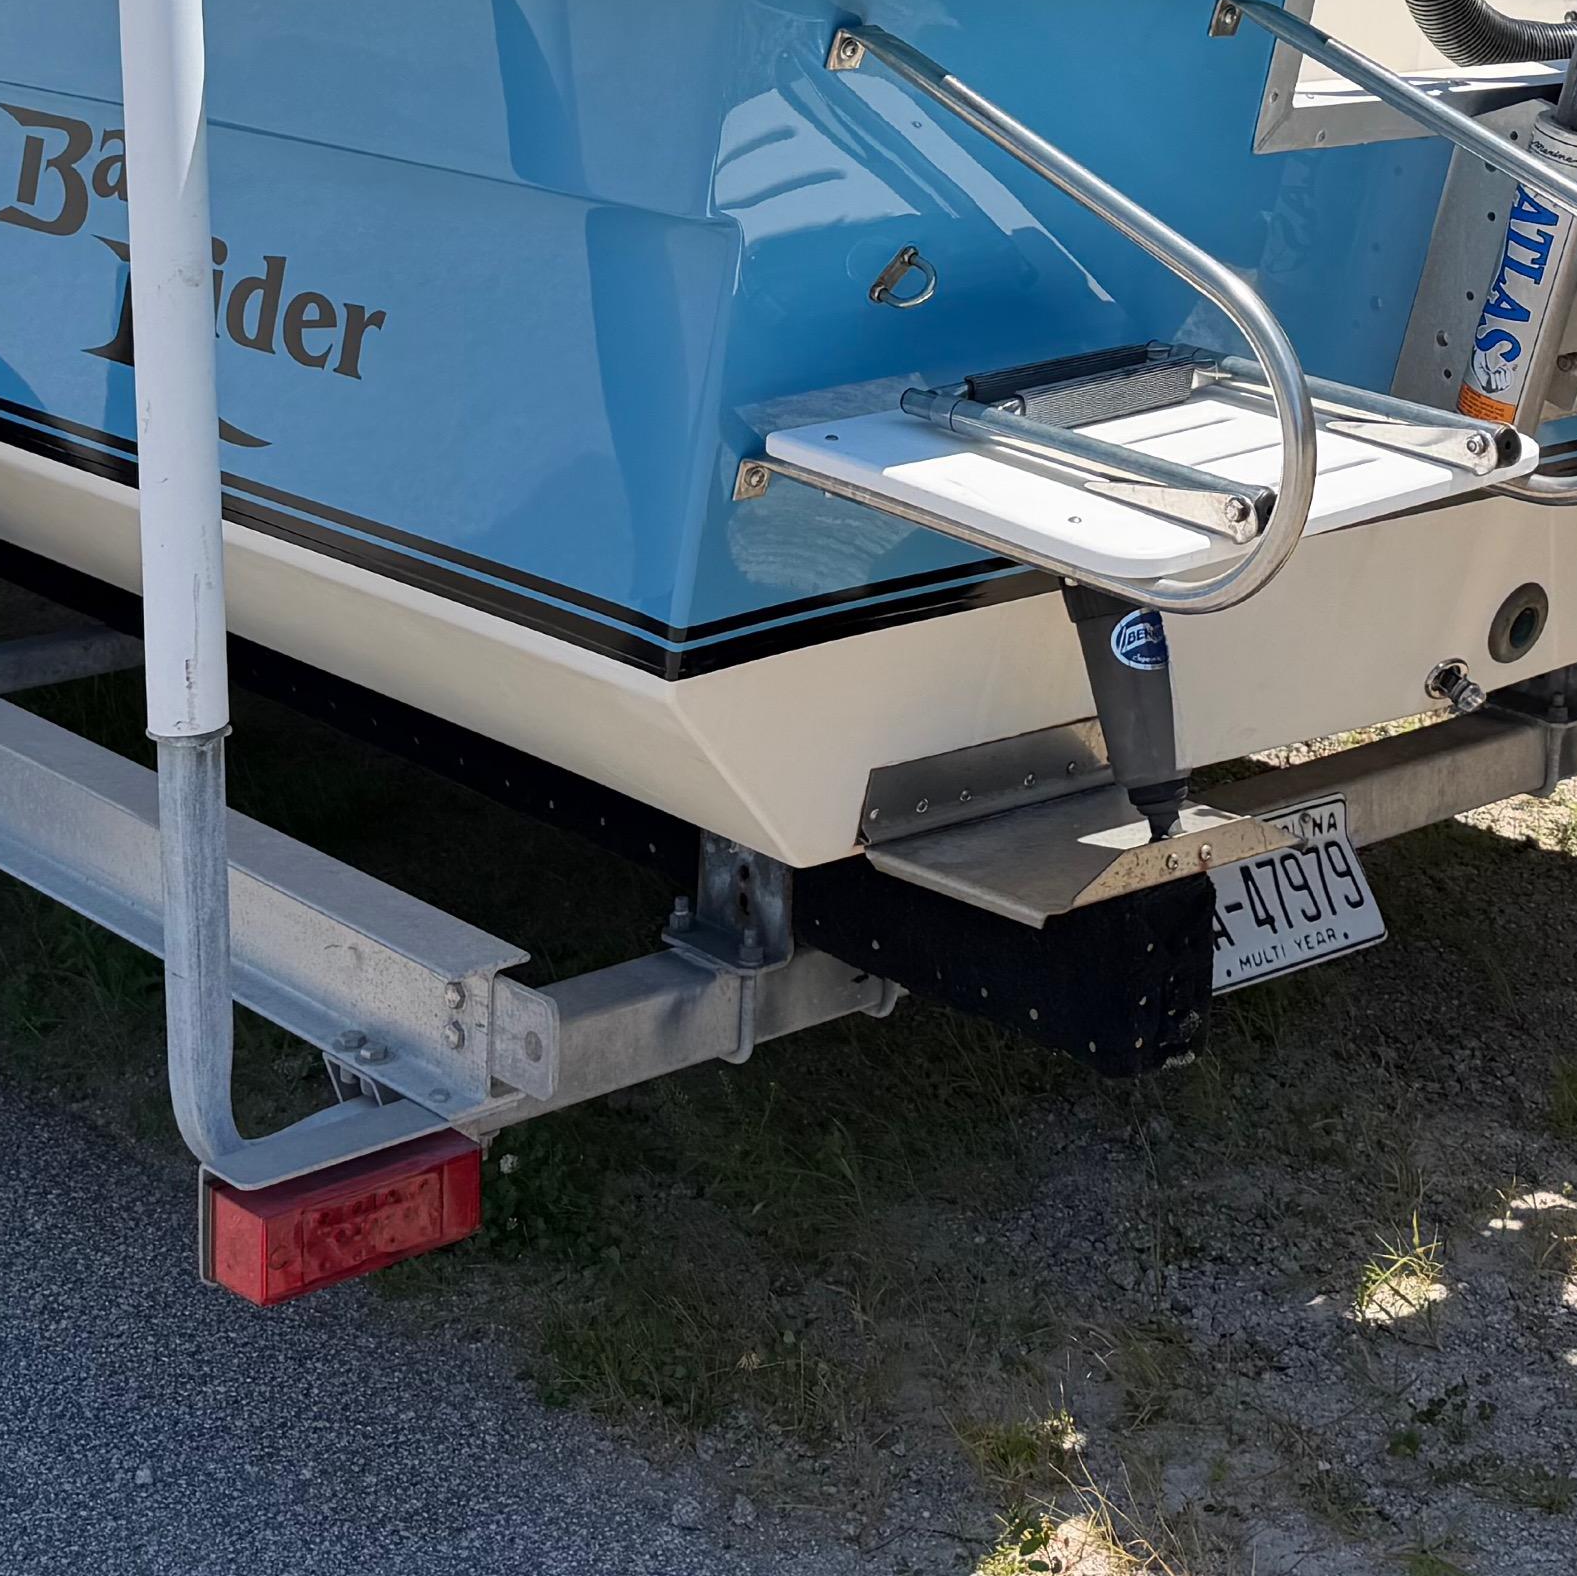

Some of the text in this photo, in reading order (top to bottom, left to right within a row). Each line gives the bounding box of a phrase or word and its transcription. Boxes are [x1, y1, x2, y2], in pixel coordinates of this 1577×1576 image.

[1474, 182, 1560, 363] ATLAS
[1213, 840, 1365, 952] A-47979
[1239, 927, 1338, 971] MULTI YEAR
